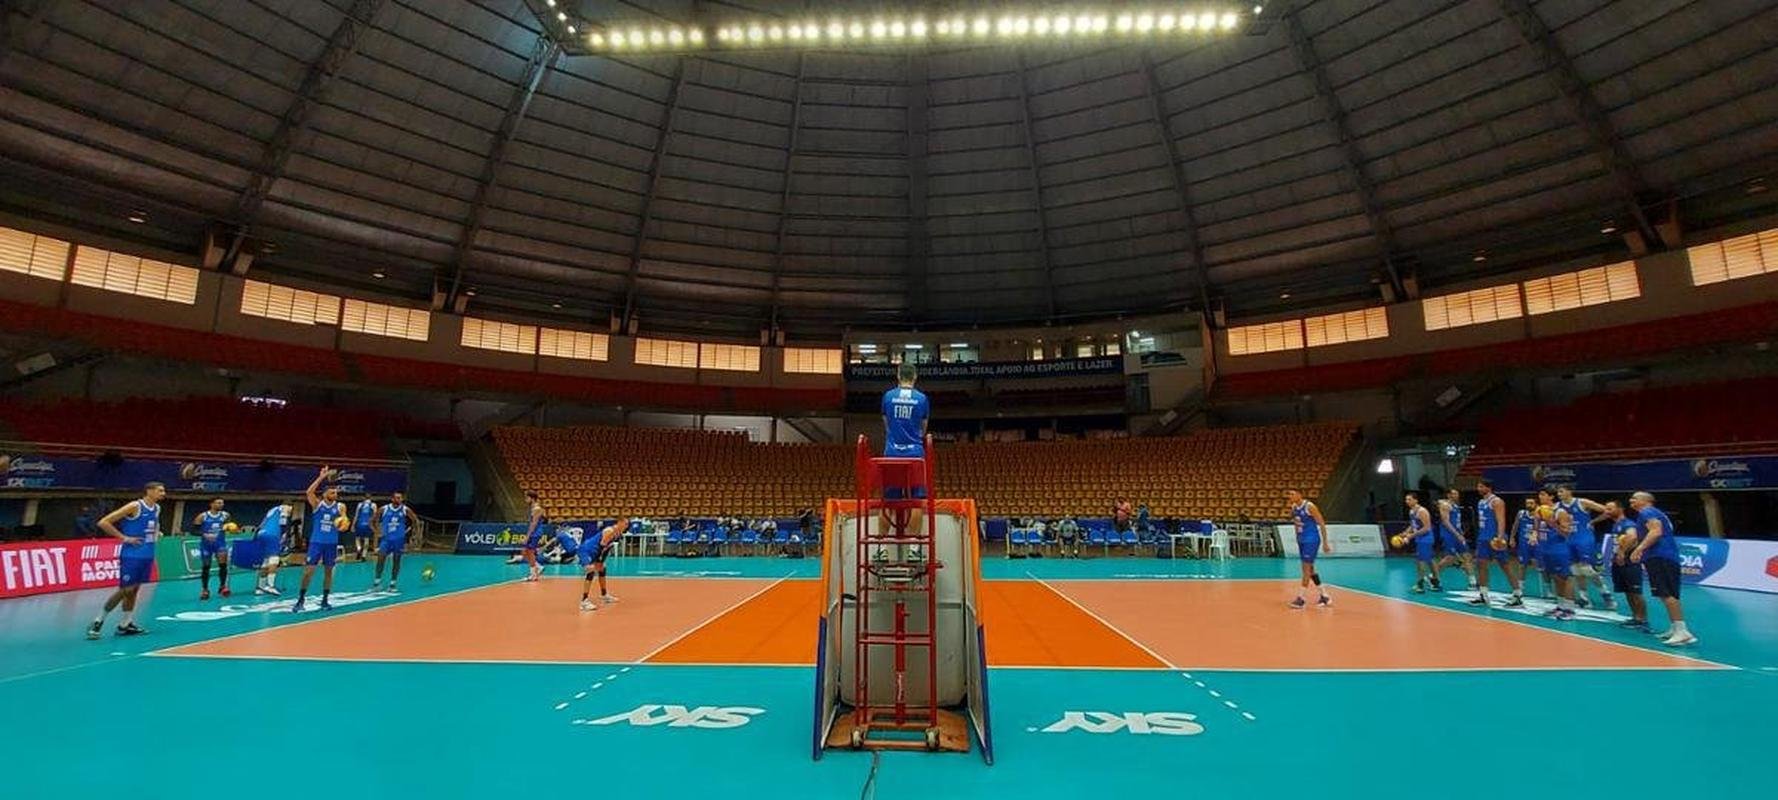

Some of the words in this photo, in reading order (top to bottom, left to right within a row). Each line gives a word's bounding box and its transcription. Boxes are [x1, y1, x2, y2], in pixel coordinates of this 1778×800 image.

[996, 364, 1022, 374] APOIO
[1037, 361, 1075, 372] ESPORTE
[1077, 360, 1084, 370] E
[1085, 359, 1113, 370] LAZER
[894, 405, 914, 419] FIAT
[2, 547, 67, 590] FIAT
[81, 561, 92, 571] A
[585, 704, 767, 728] SKY
[1040, 711, 1204, 735] SKY
